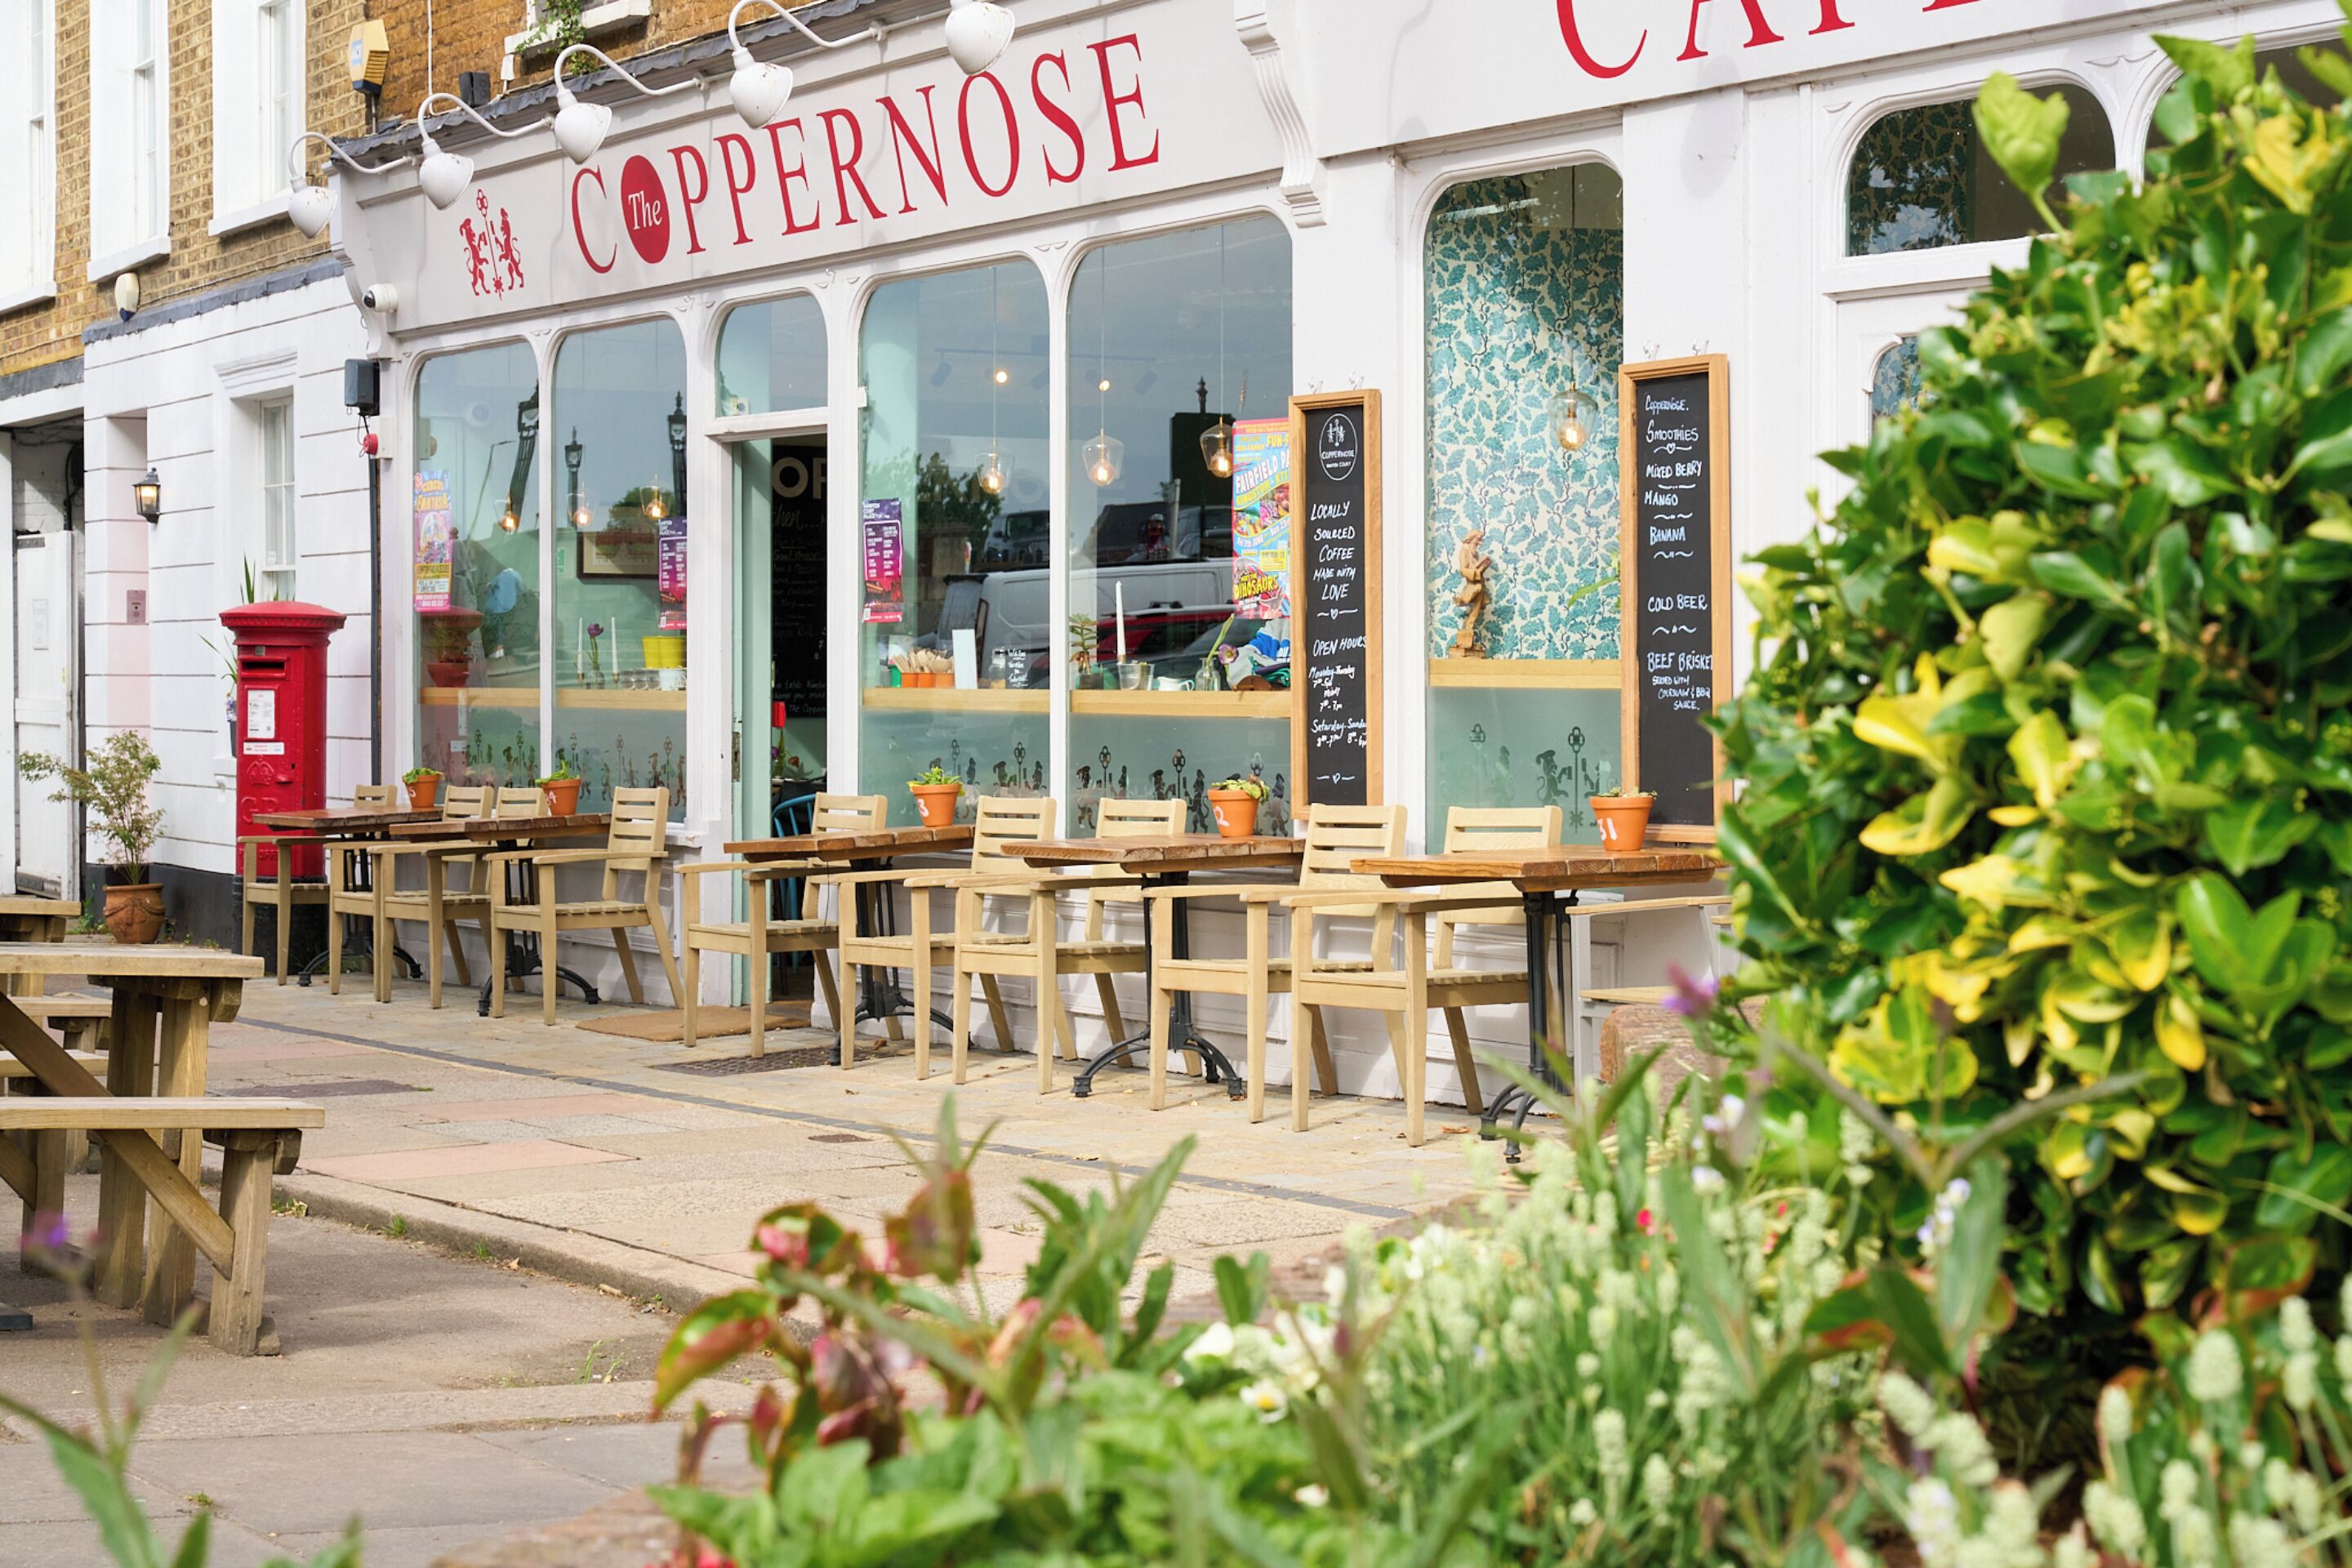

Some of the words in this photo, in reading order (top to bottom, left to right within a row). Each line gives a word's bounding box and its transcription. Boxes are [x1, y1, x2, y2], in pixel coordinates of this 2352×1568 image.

[571, 33, 1160, 274] COPPERNOSE
[627, 189, 662, 230] The
[1236, 455, 1277, 494] FAIRFIELD
[1675, 460, 1703, 477] BERRY
[1644, 490, 1679, 506] MANGO
[1311, 501, 1351, 521] LOCALLY
[1650, 526, 1686, 546] BANANA
[1232, 575, 1279, 600] DINOSAURS
[1321, 583, 1349, 601] LOVE
[1648, 596, 1673, 612] COLD
[1677, 594, 1708, 610] BEER
[1313, 639, 1338, 657] OPEN
[1647, 652, 1676, 672] BEEF
